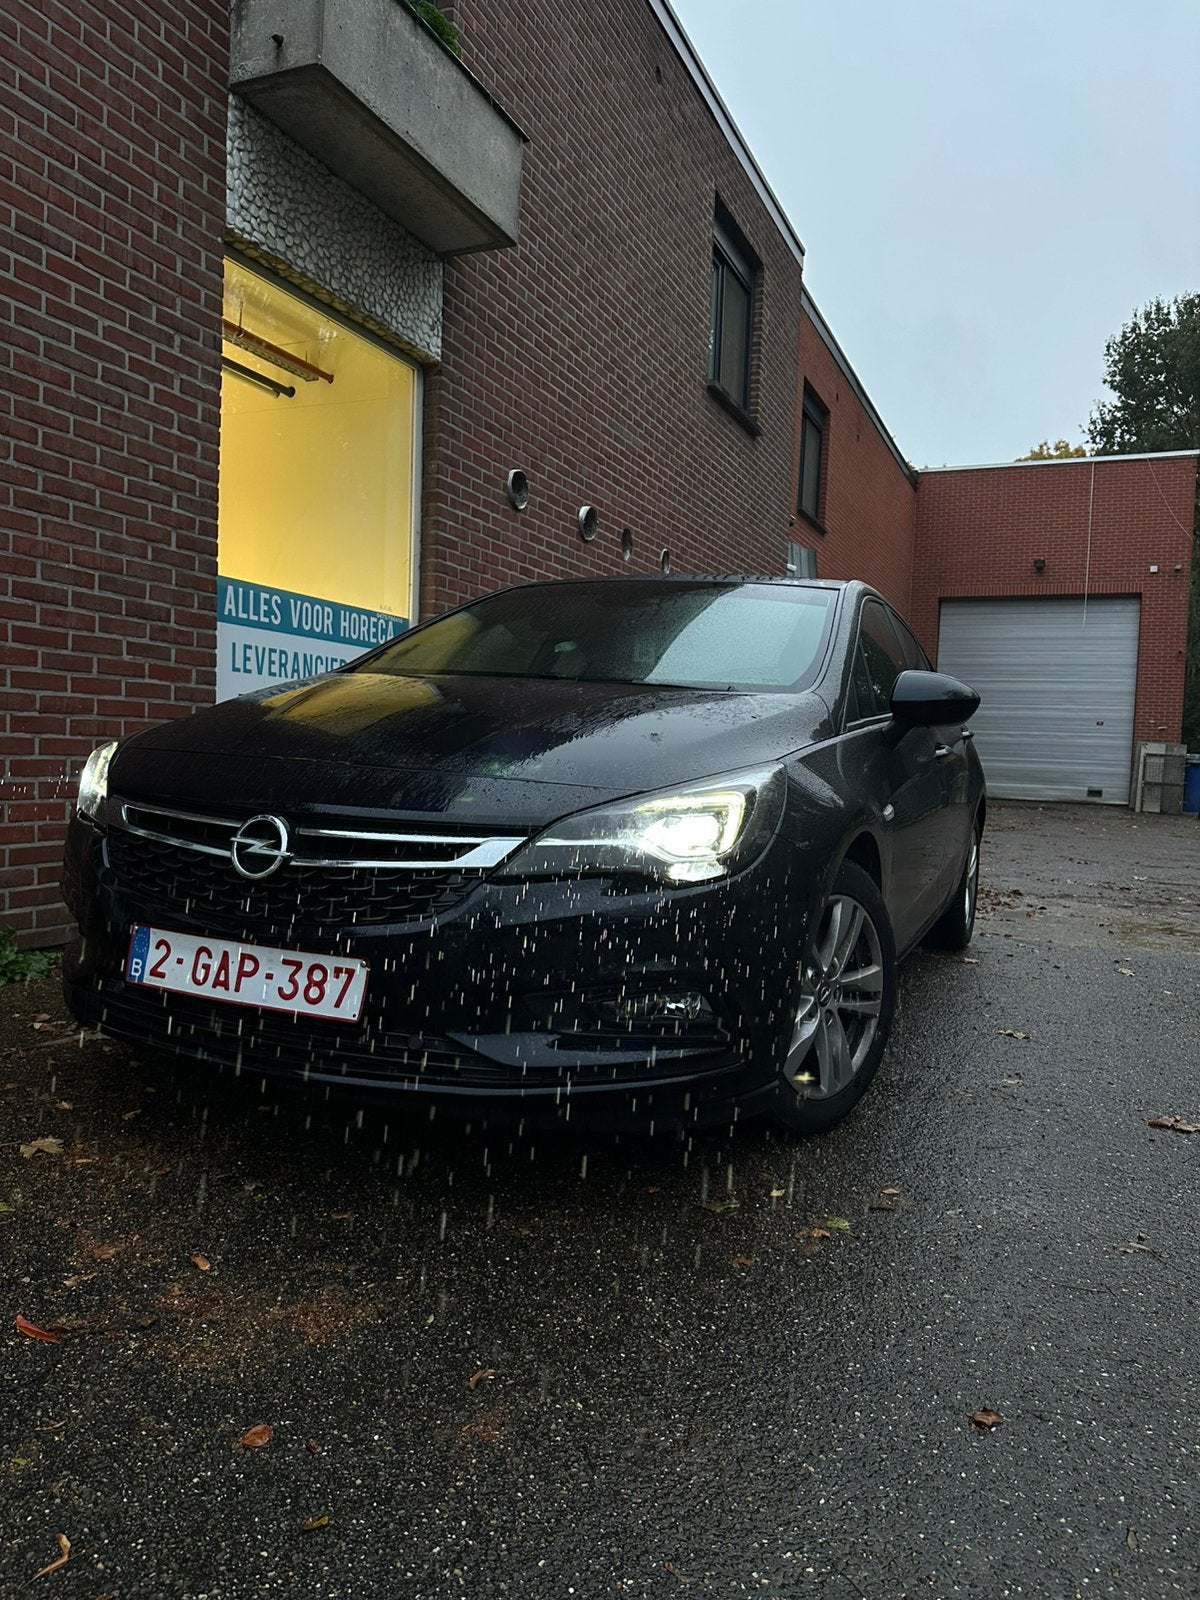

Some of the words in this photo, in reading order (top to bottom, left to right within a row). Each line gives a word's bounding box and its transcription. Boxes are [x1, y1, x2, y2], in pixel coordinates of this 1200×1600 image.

[224, 585, 282, 625] ALLES
[290, 599, 333, 635] VOOR
[340, 610, 395, 644] HORECA
[131, 959, 143, 976] B
[149, 938, 355, 1009] 2-GAP-387
